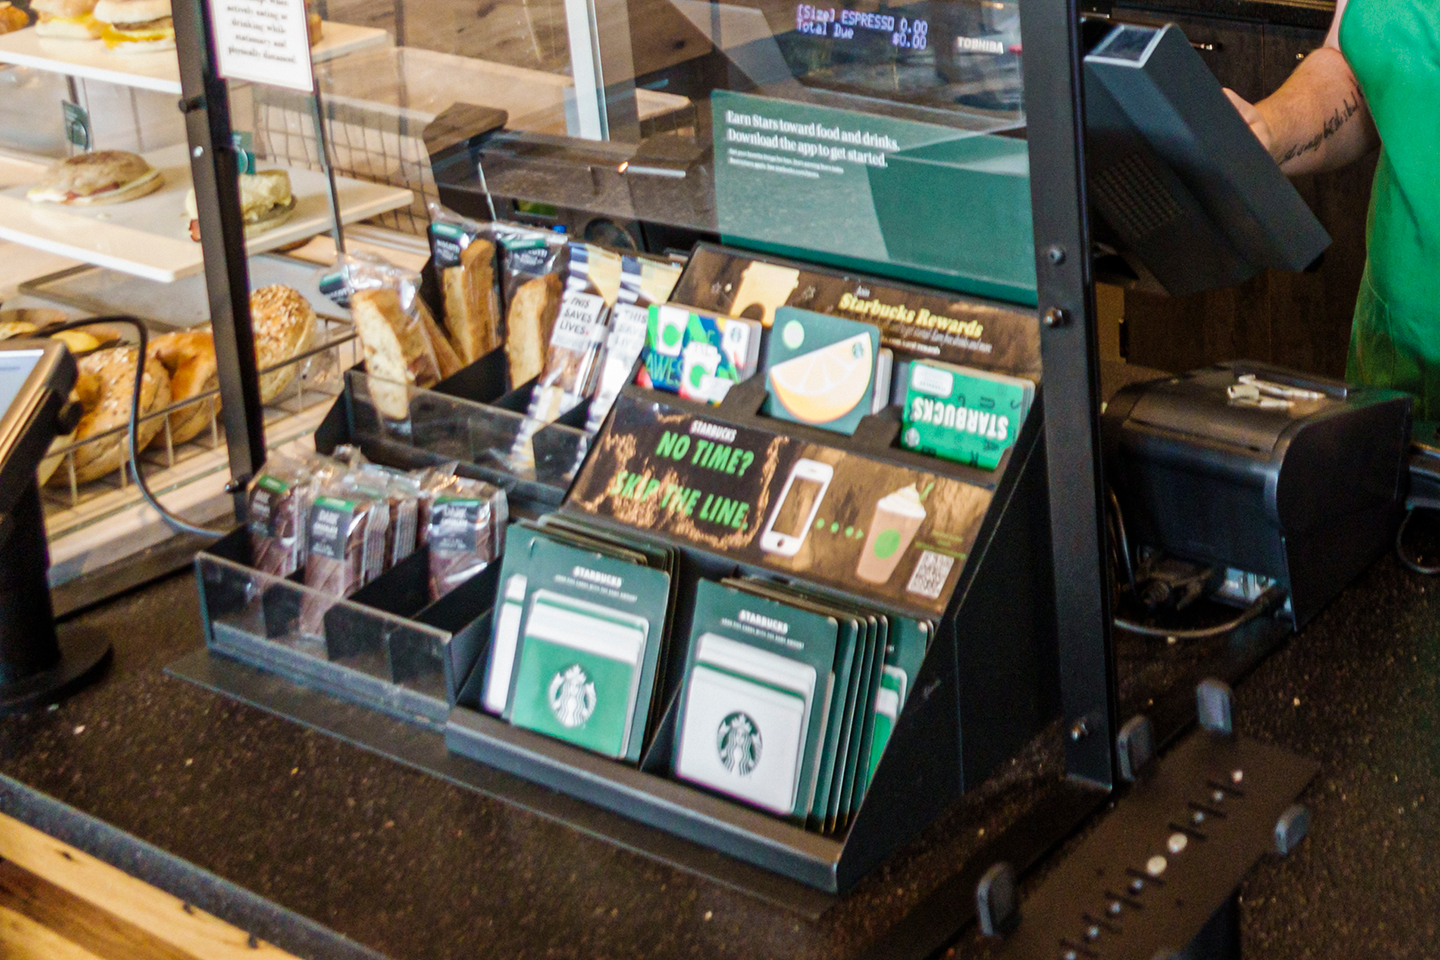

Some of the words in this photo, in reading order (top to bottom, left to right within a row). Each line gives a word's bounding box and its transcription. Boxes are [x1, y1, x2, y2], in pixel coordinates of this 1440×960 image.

[797, 19, 828, 36] Total
[834, 24, 854, 39] Due
[892, 31, 927, 50] $0.00
[841, 9, 895, 32] ESPRESSO
[900, 18, 928, 35] 0.00
[957, 36, 1004, 54] TOSHIBA
[726, 110, 751, 125] Earn
[752, 114, 778, 130] Stars
[779, 118, 815, 137] toward
[816, 123, 840, 140] food
[841, 130, 861, 145] and
[862, 131, 900, 151] drinks.
[727, 128, 778, 149] Download
[779, 136, 797, 151] the
[798, 142, 817, 158] app
[818, 144, 830, 155] to
[830, 147, 847, 161] get
[848, 150, 888, 168] started.
[560, 322, 589, 336] LIVES.
[564, 309, 593, 324] SAVES
[839, 292, 915, 324] Starbucks
[916, 308, 984, 339] Rewards
[690, 420, 737, 443] STARBUCKS
[911, 395, 1010, 440] STARBUCKS
[655, 430, 691, 461] NO
[691, 439, 755, 477] TIME?
[610, 470, 660, 503] SKIP
[660, 484, 702, 516] THE
[699, 493, 750, 531] LINE.
[572, 566, 623, 589] STARBUCKS
[738, 609, 789, 635] STARBUCKS
